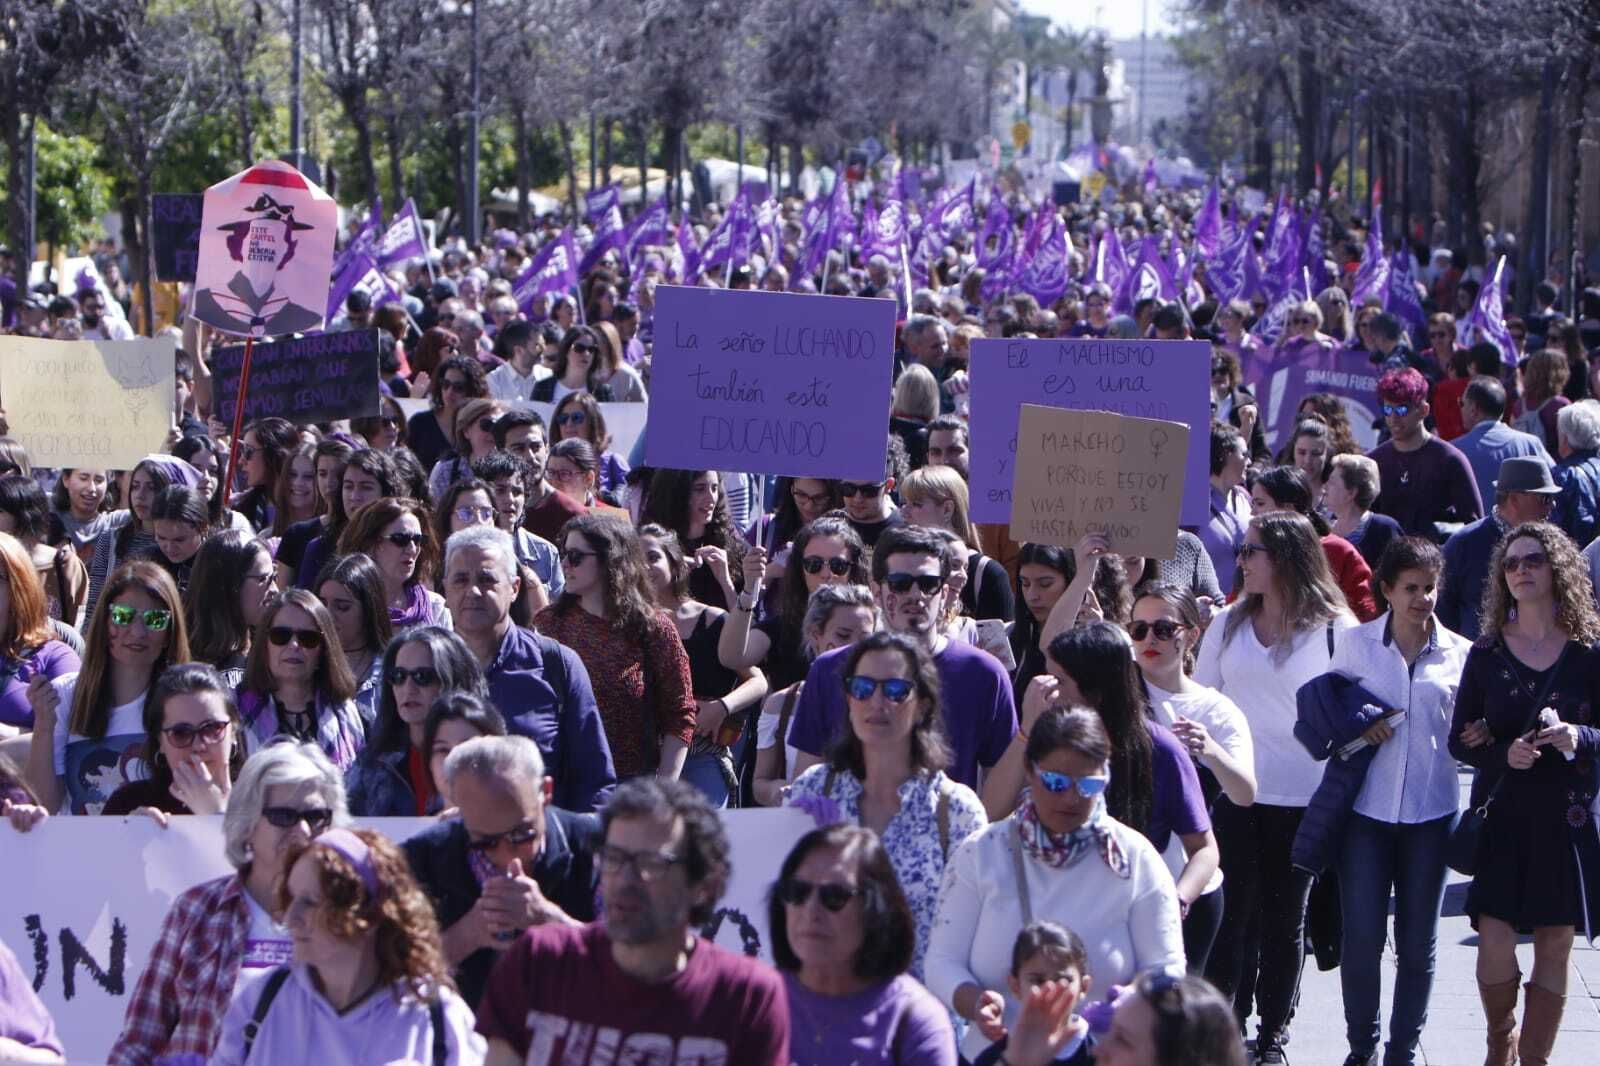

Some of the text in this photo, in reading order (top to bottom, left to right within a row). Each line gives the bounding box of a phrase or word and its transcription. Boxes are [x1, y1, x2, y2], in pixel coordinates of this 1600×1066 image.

[674, 321, 876, 360] La seño LUCHANDO
[1058, 344, 1155, 367] MACHISMO
[688, 363, 832, 407] también está
[1043, 373, 1152, 393] es una
[700, 415, 827, 458] EDUCANDO
[1041, 432, 1125, 454] MARCHO
[1047, 465, 1169, 490] PORQUE ESTOY
[1031, 497, 1065, 513] VIVA
[1031, 520, 1078, 537] HASTA
